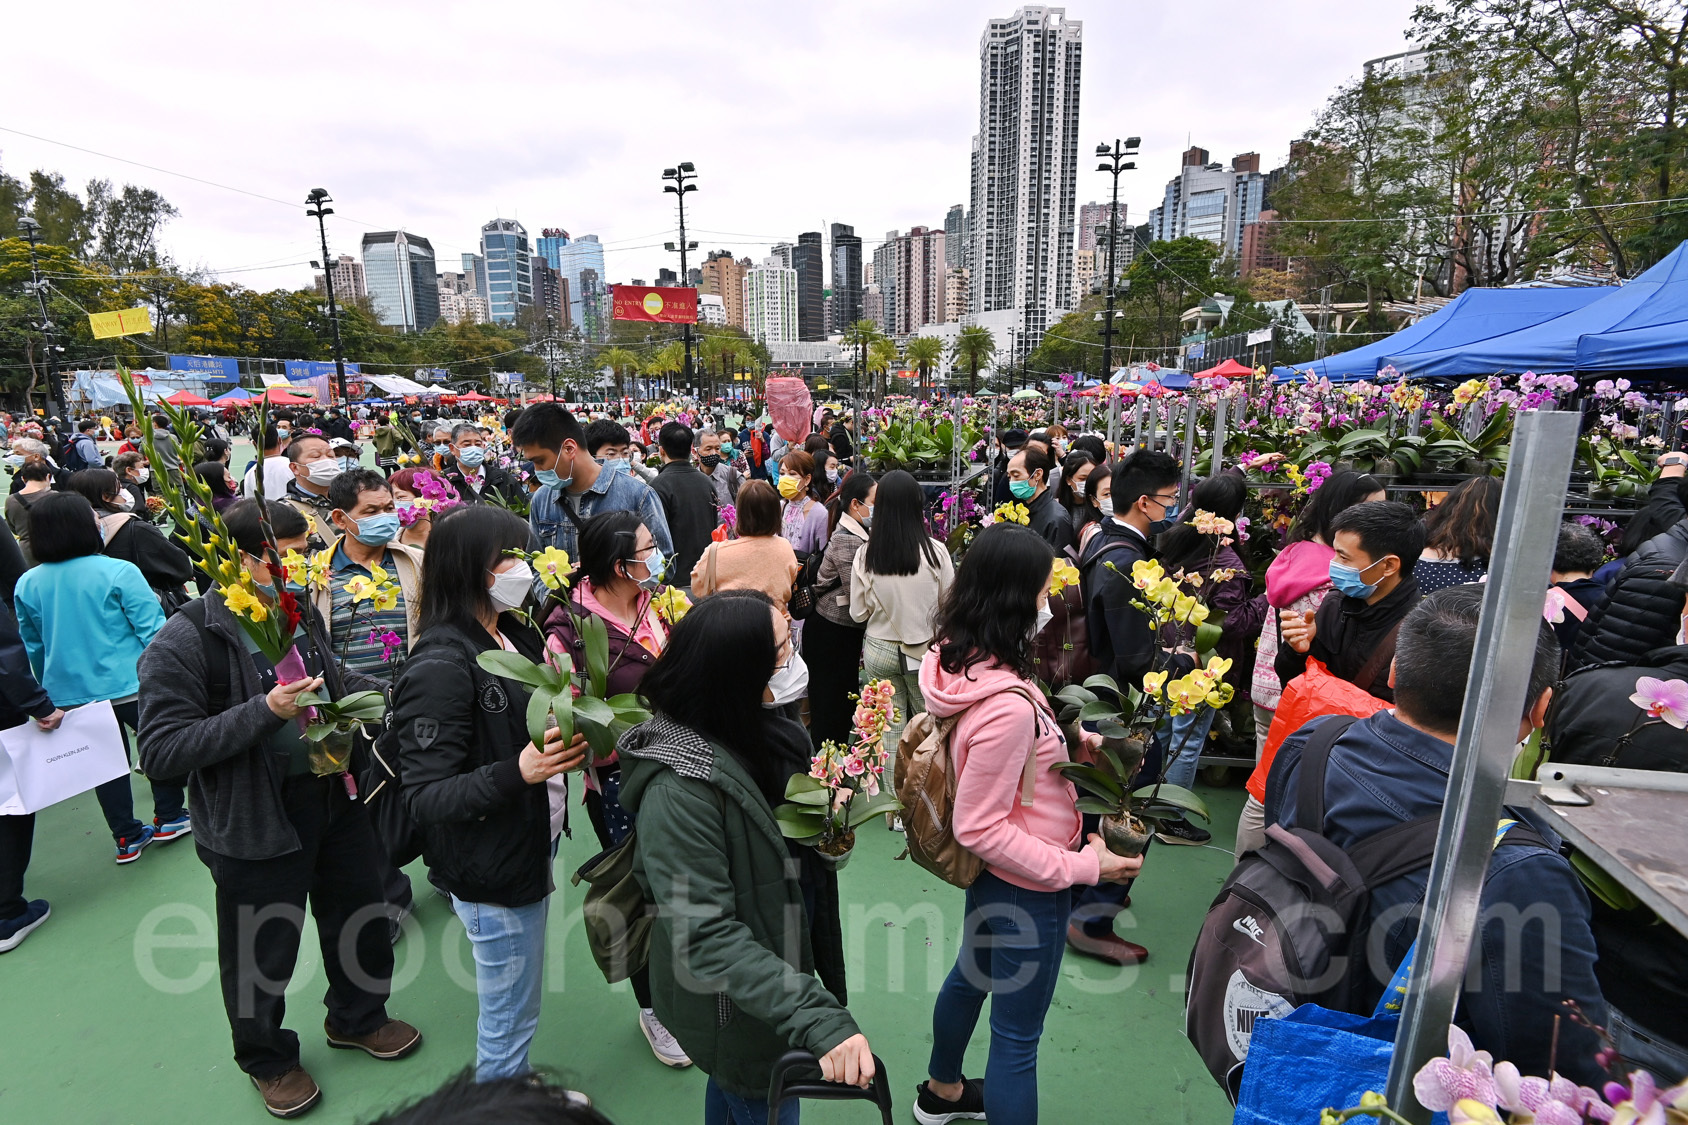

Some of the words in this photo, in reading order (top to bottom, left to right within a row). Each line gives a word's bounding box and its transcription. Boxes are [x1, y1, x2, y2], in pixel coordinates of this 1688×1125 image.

[46, 753, 63, 764] CALVIN
[63, 748, 77, 758] KLEIN
[76, 745, 90, 755] JEANS
[1241, 915, 1264, 937] NIKE
